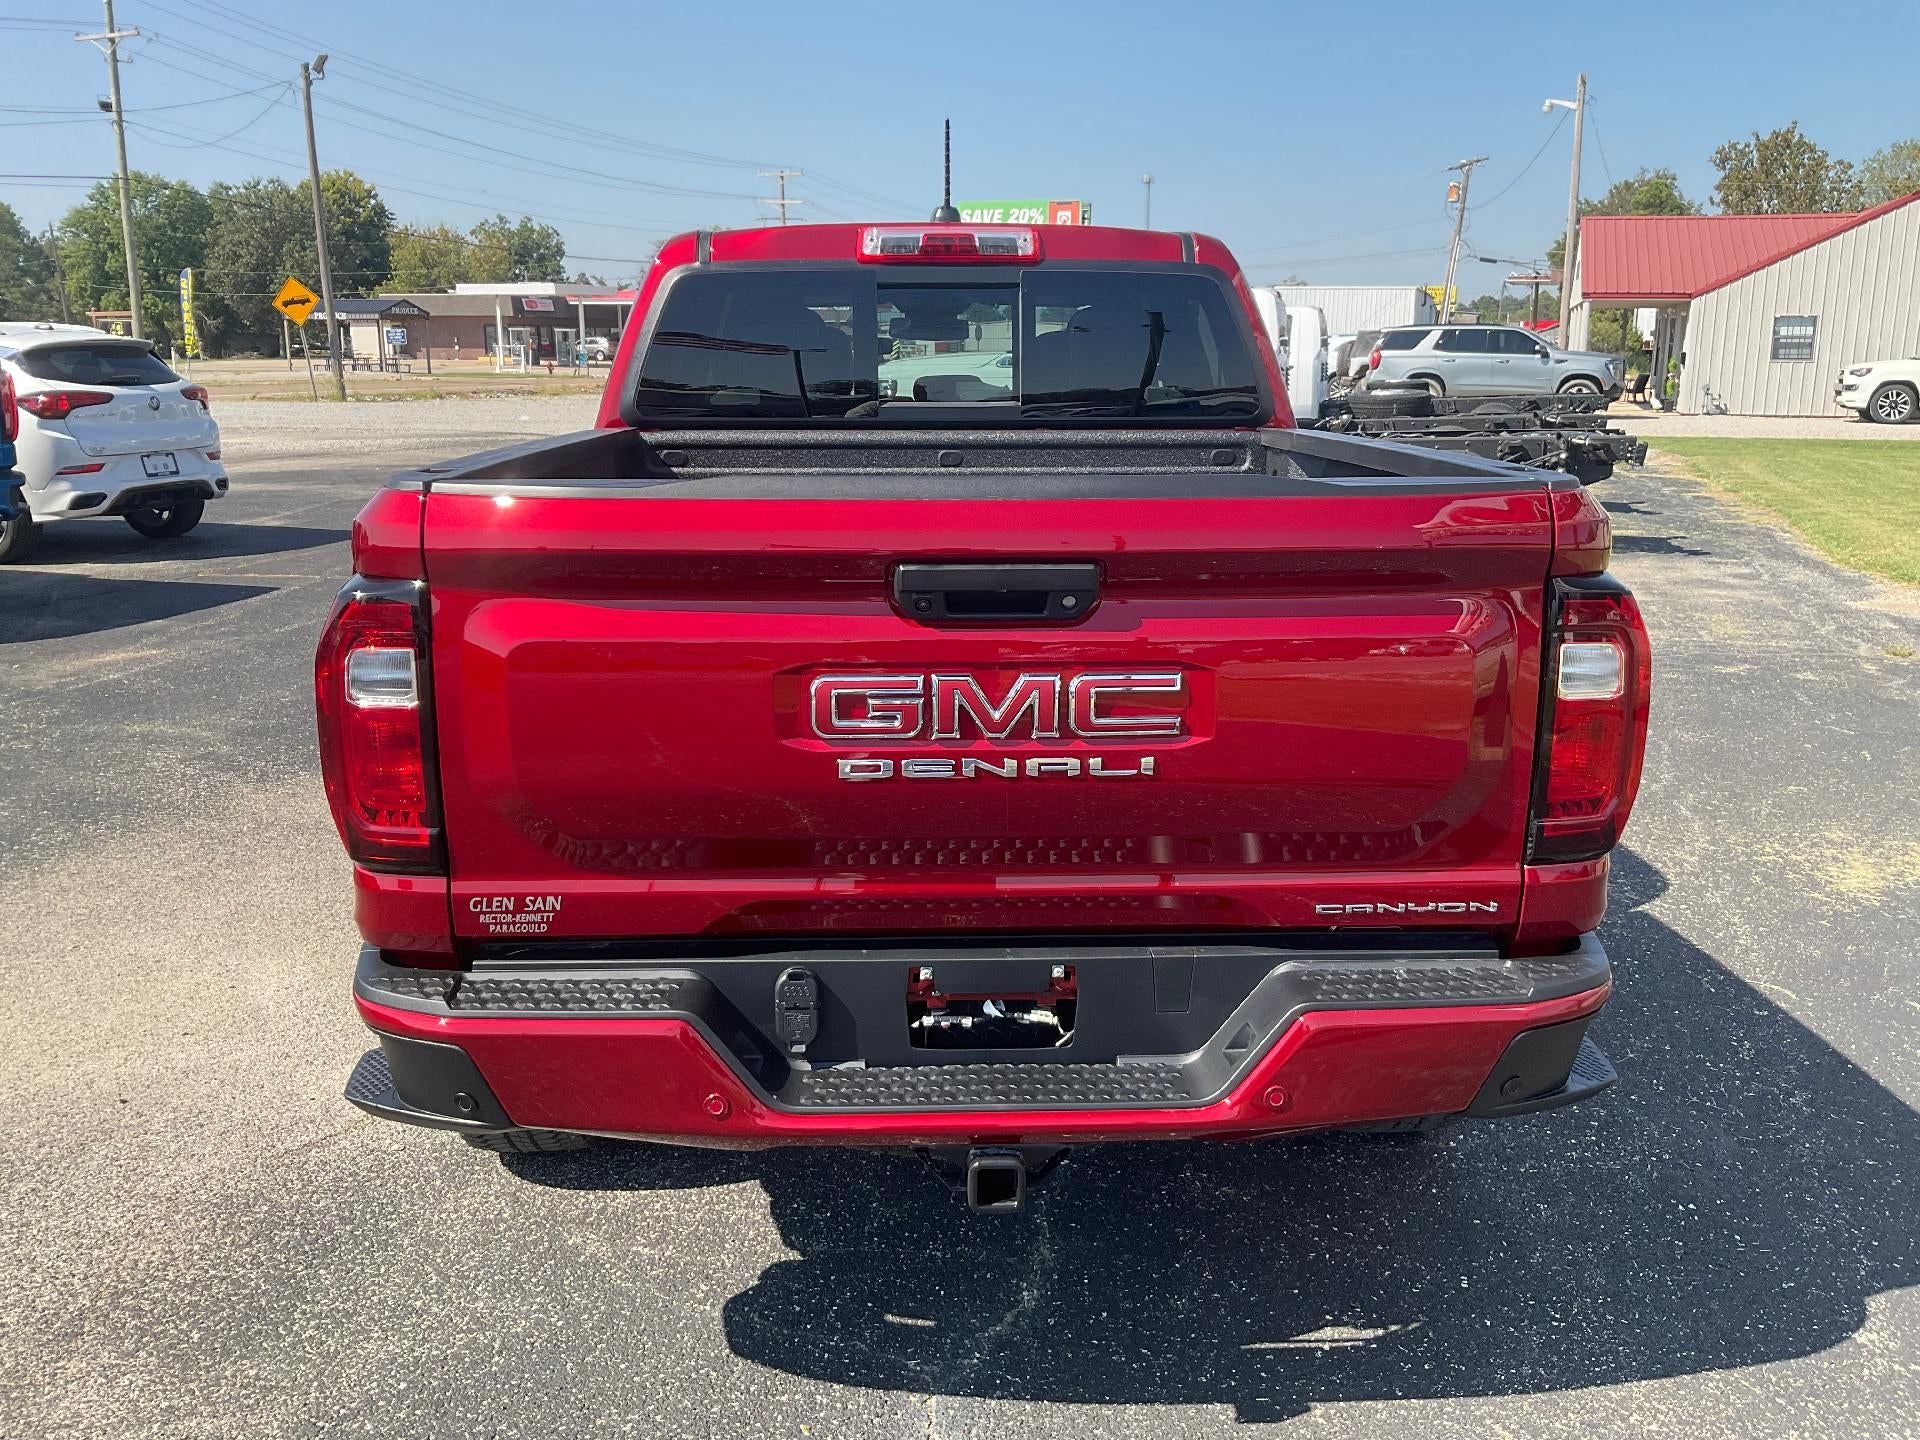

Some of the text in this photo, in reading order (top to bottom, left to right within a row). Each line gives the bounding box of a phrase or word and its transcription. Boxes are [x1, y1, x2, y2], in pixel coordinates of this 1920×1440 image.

[961, 208, 1043, 224] SAVE 20%
[810, 673, 1182, 739] GMC
[837, 756, 1155, 778] DENALI
[469, 896, 561, 911] GLEN SAIN
[1315, 901, 1498, 913] CANYON
[480, 912, 554, 922] RECTOR-KENNETT
[489, 924, 547, 932] PARAGOULD
